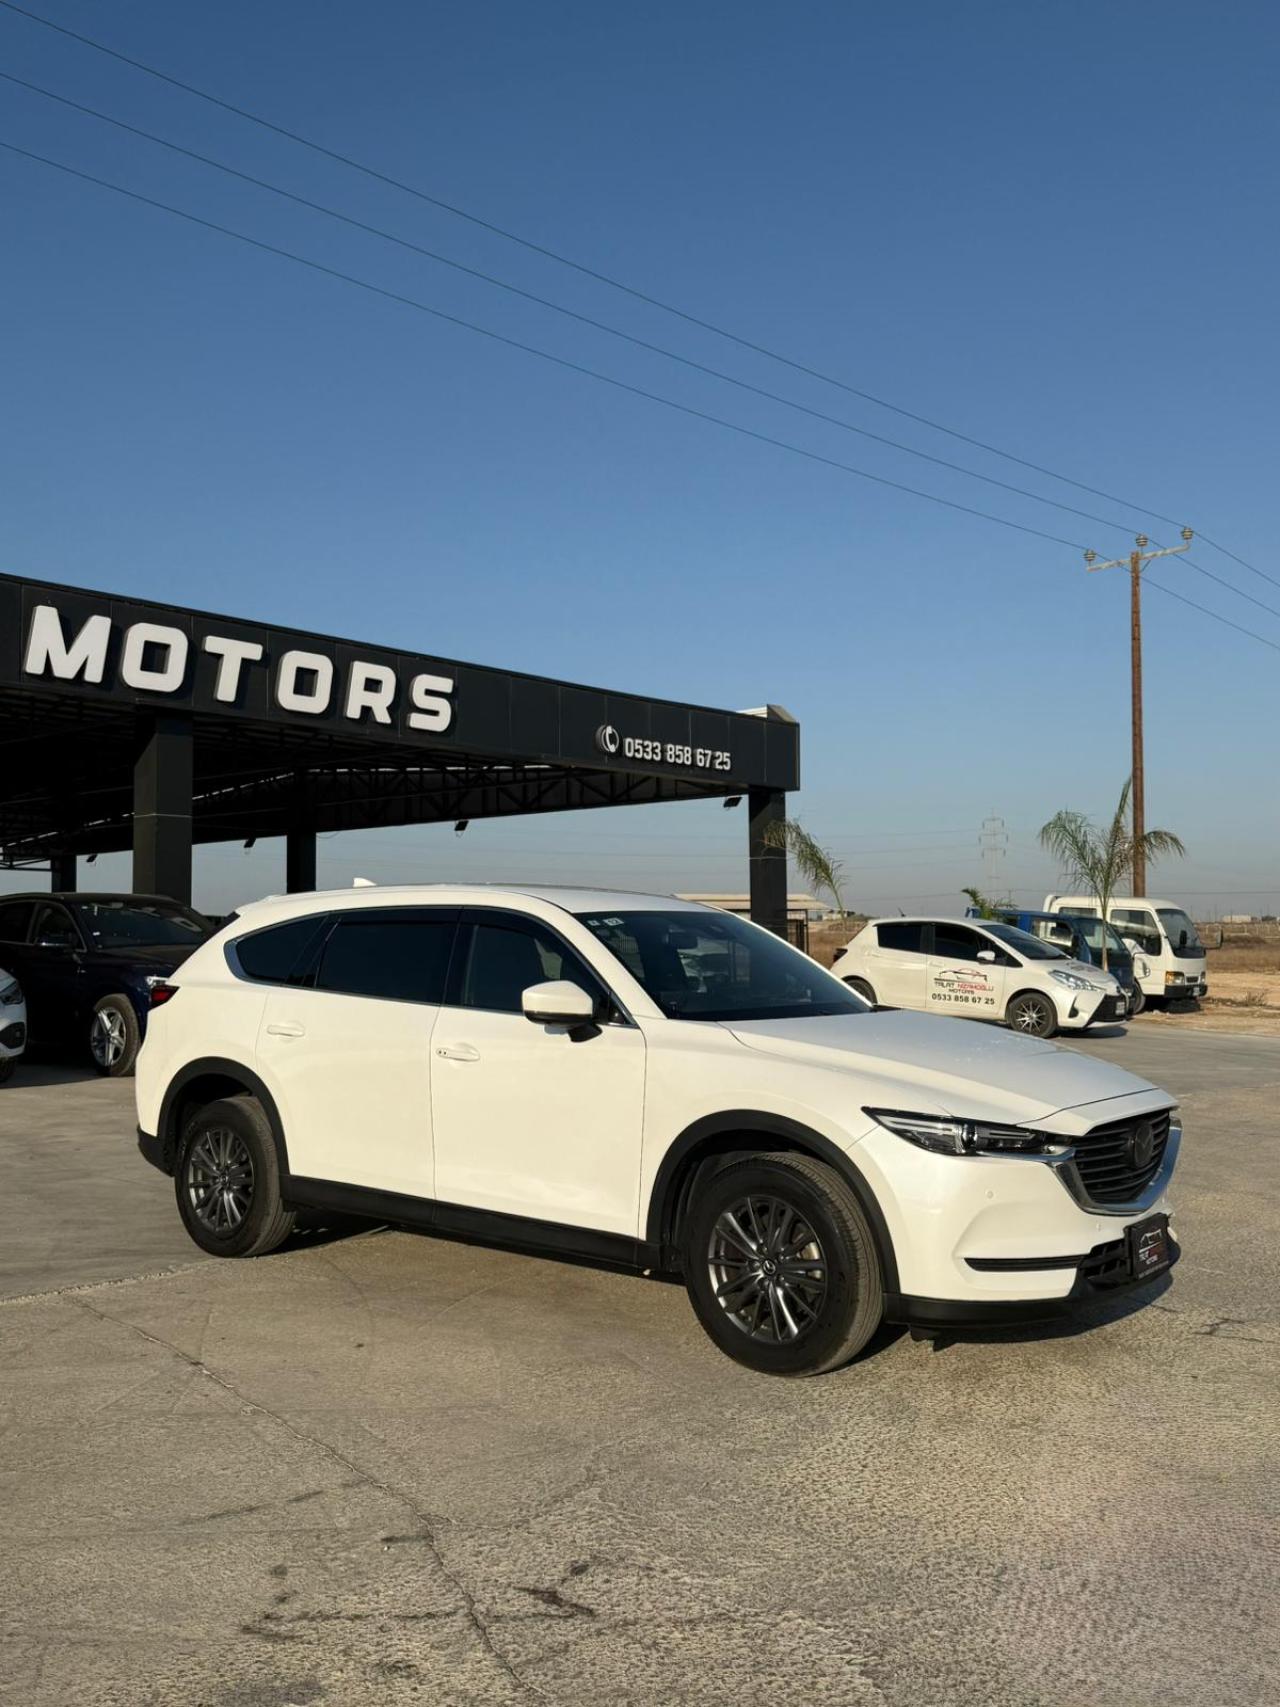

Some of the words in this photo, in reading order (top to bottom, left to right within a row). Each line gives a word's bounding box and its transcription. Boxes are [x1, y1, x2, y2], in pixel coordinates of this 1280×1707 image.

[24, 604, 454, 733] MOTORS
[624, 737, 662, 761] 0533
[666, 743, 692, 765] 858
[932, 993, 952, 1001] 0533
[954, 994, 970, 1003] 858
[972, 996, 982, 1004] 67
